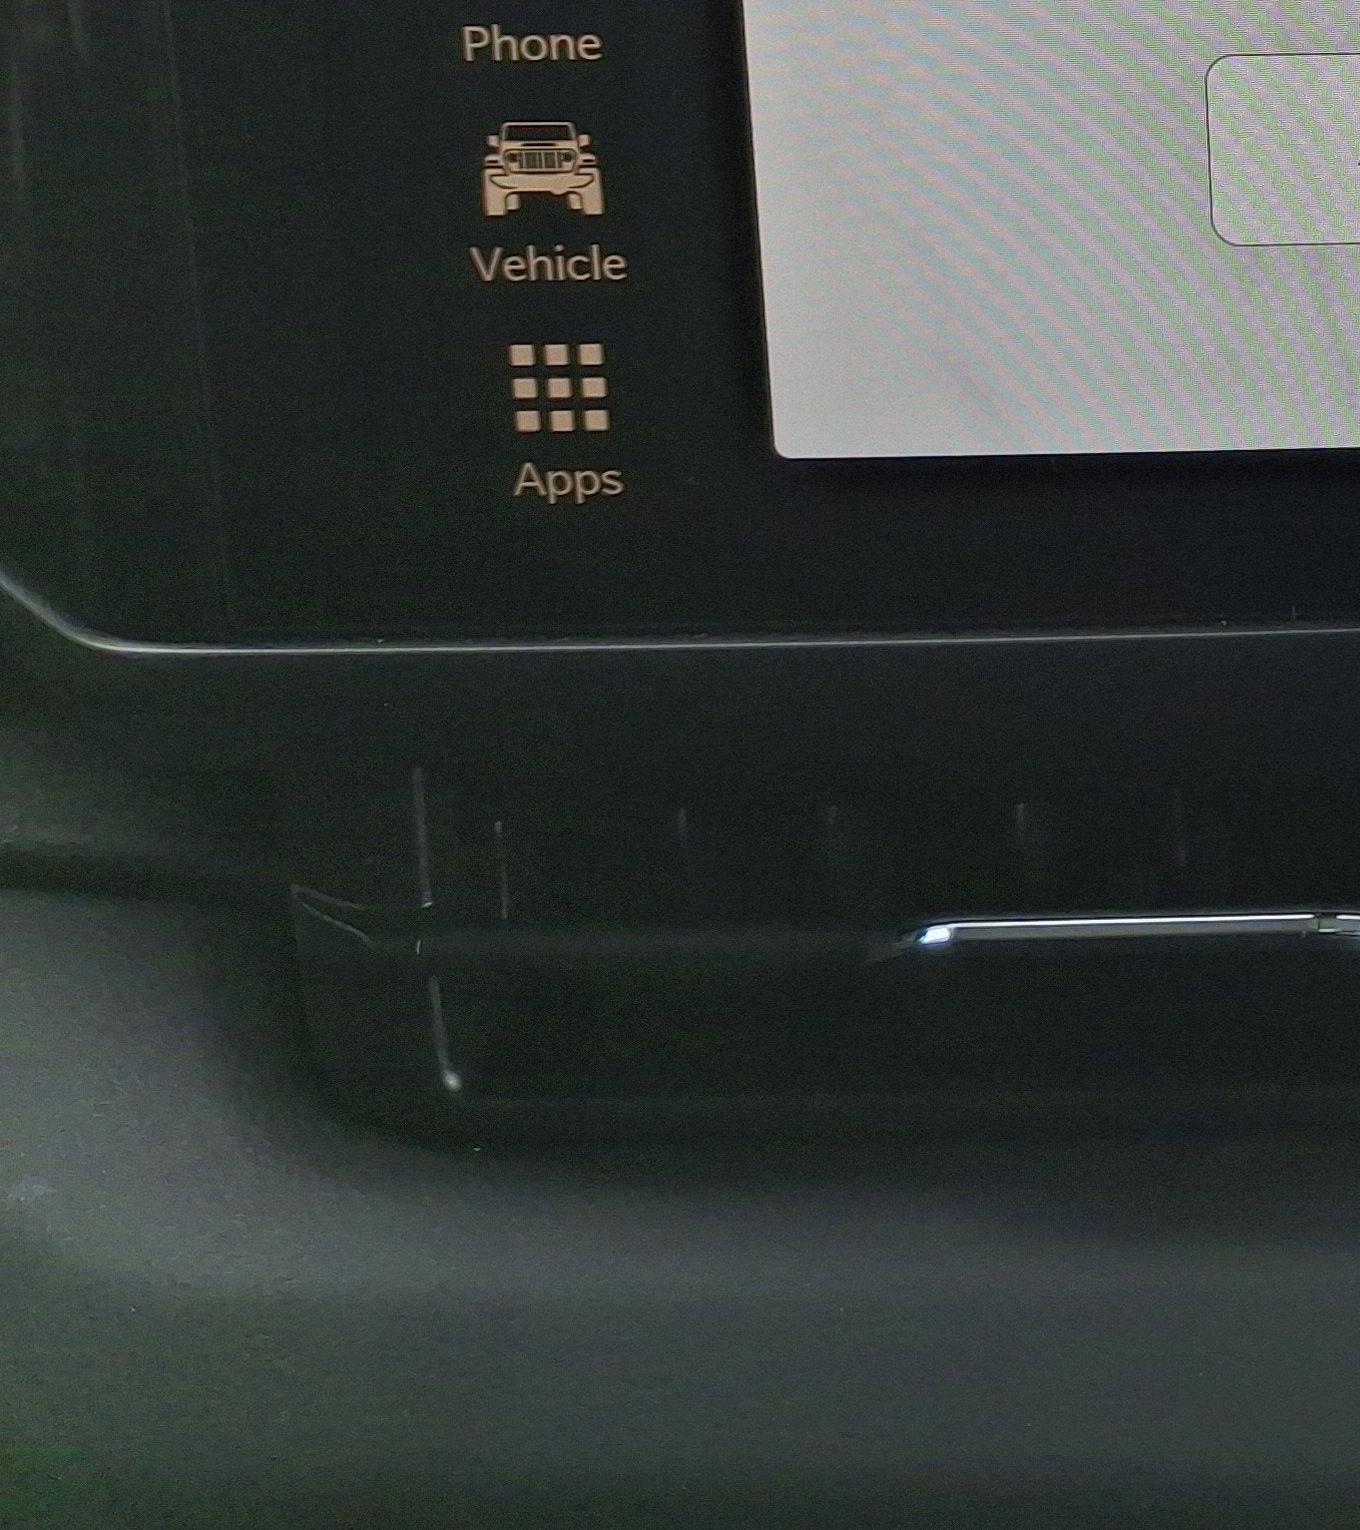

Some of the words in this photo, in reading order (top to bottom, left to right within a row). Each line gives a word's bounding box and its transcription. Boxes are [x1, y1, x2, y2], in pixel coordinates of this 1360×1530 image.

[461, 22, 603, 63] Phone
[469, 243, 628, 284] Vehicle
[512, 460, 625, 506] Apps
